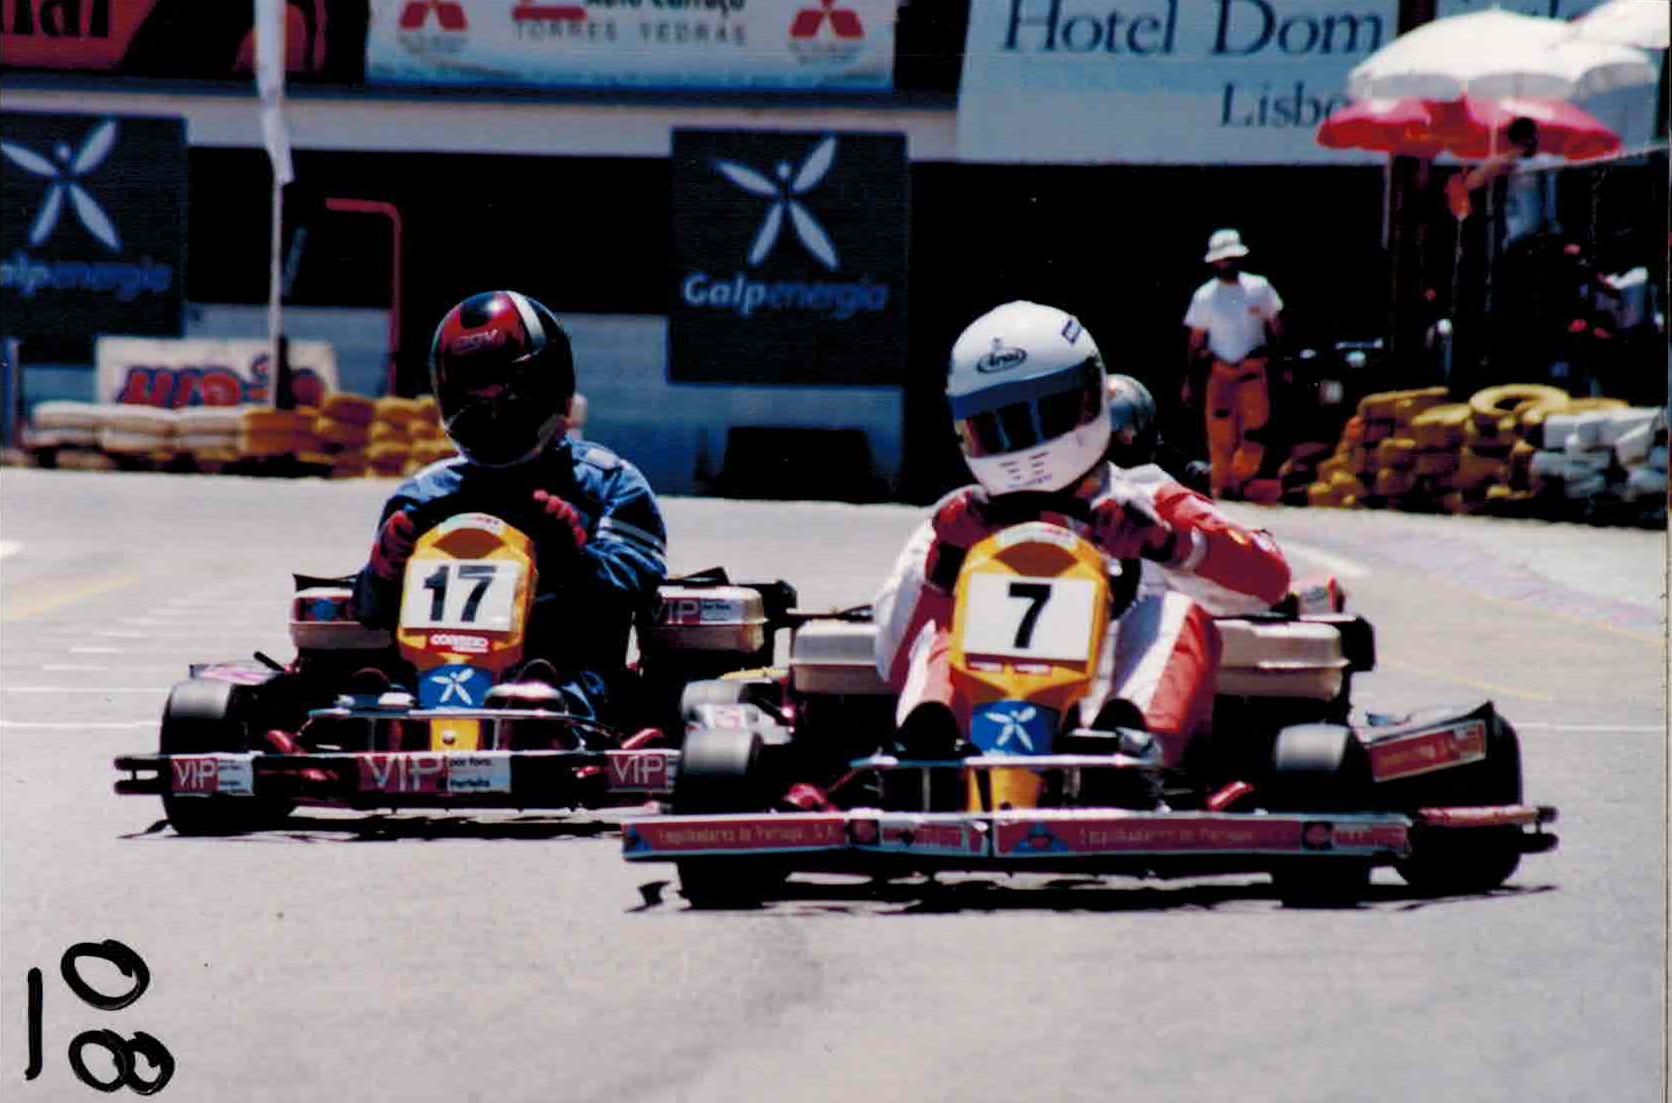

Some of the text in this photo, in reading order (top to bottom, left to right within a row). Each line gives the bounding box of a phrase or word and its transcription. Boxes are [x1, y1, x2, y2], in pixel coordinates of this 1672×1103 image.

[1002, 0, 1179, 54] Hotel
[1209, 0, 1388, 55] Dom
[423, 564, 497, 622] 17
[1008, 582, 1053, 649] 7
[173, 759, 217, 790] VIP
[364, 754, 444, 791] VIP
[612, 755, 664, 784] VIP
